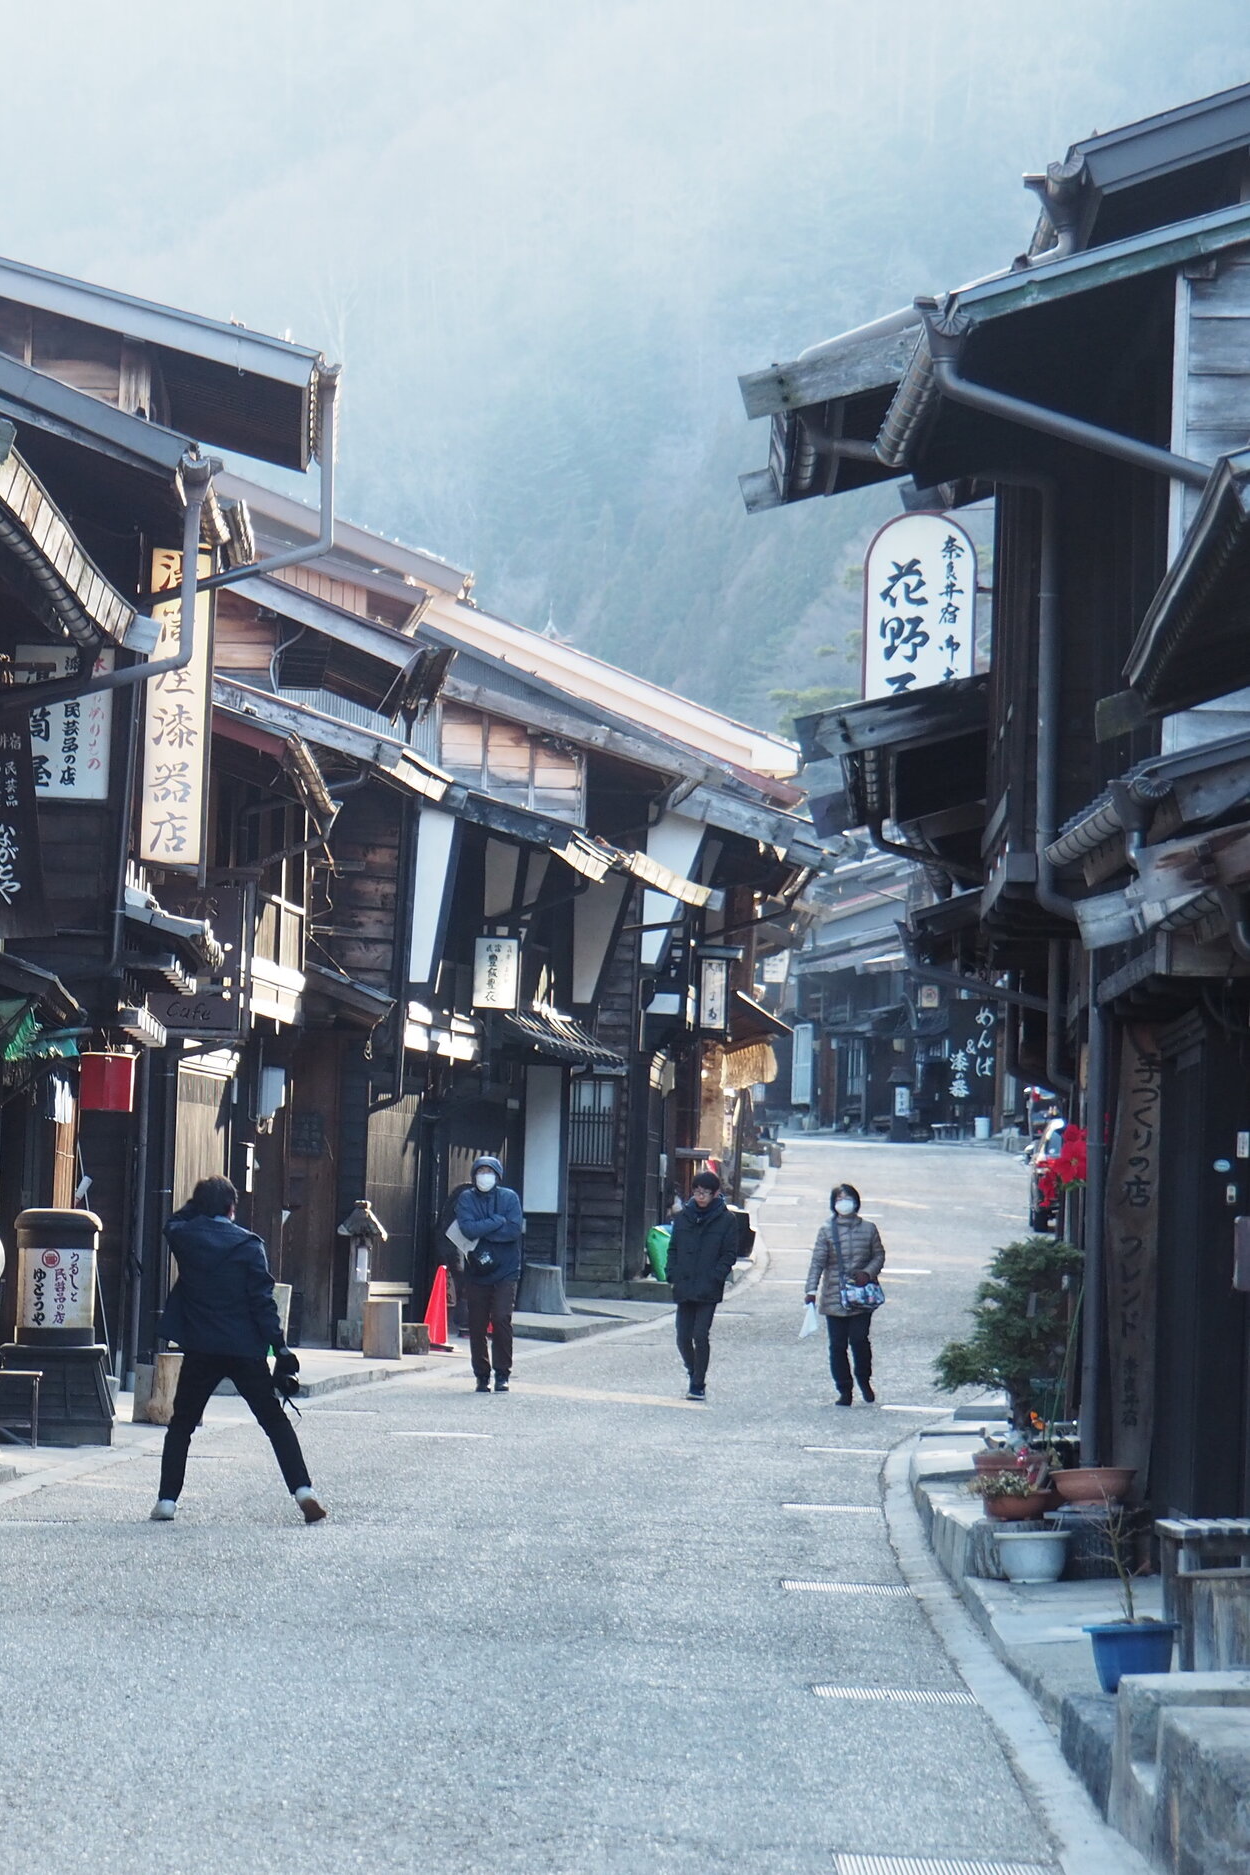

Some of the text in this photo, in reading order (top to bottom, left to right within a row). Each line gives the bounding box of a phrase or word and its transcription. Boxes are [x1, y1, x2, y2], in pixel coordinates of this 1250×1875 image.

[60, 656, 81, 786] 漆民芸品の店
[4, 760, 19, 807] 民芸品
[949, 1050, 970, 1098] 漆の器
[31, 1268, 47, 1326] ゆとうや
[69, 1251, 81, 1303] うるしと
